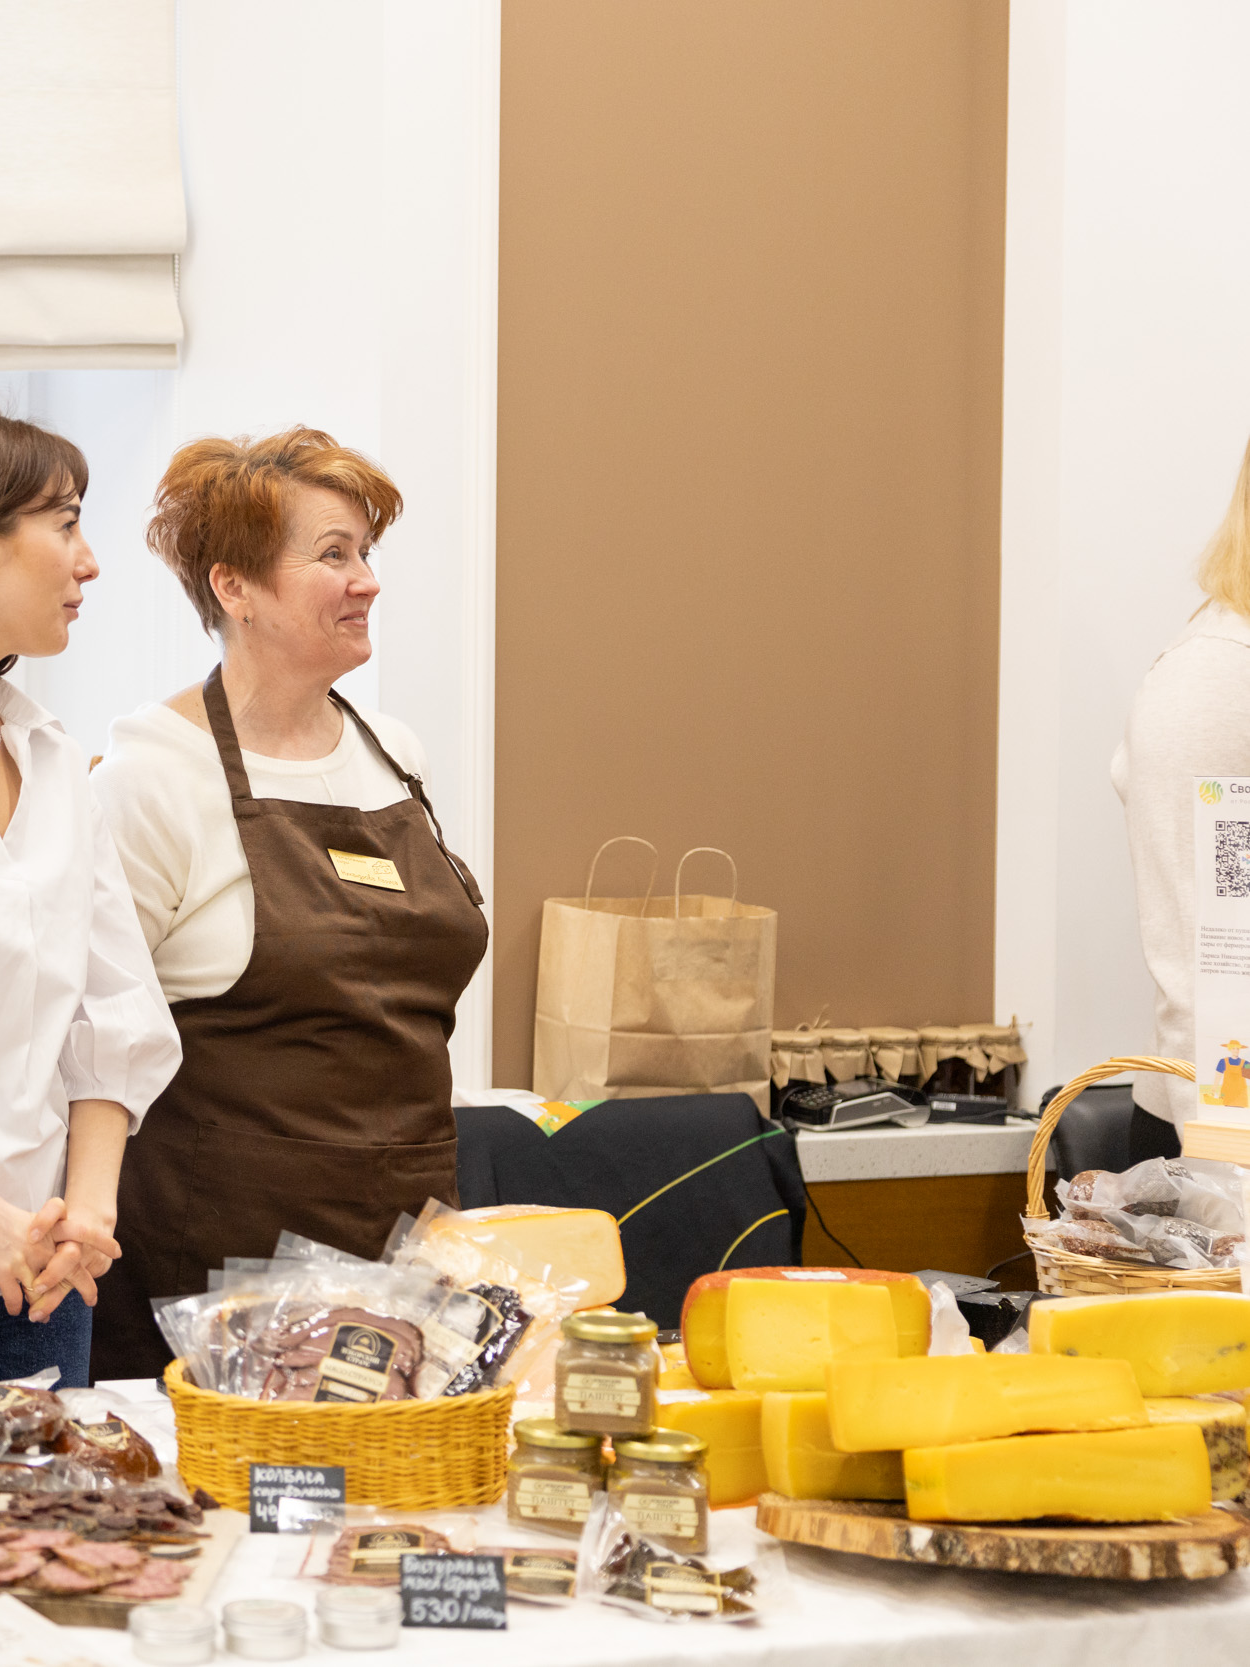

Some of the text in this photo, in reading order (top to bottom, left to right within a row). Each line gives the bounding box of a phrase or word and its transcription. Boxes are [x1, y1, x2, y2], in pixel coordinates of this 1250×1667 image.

[580, 1391, 623, 1402] ПАШТЕТ
[532, 1495, 576, 1507] ПАШТЕТ
[637, 1511, 682, 1523] ПАШТЕТ
